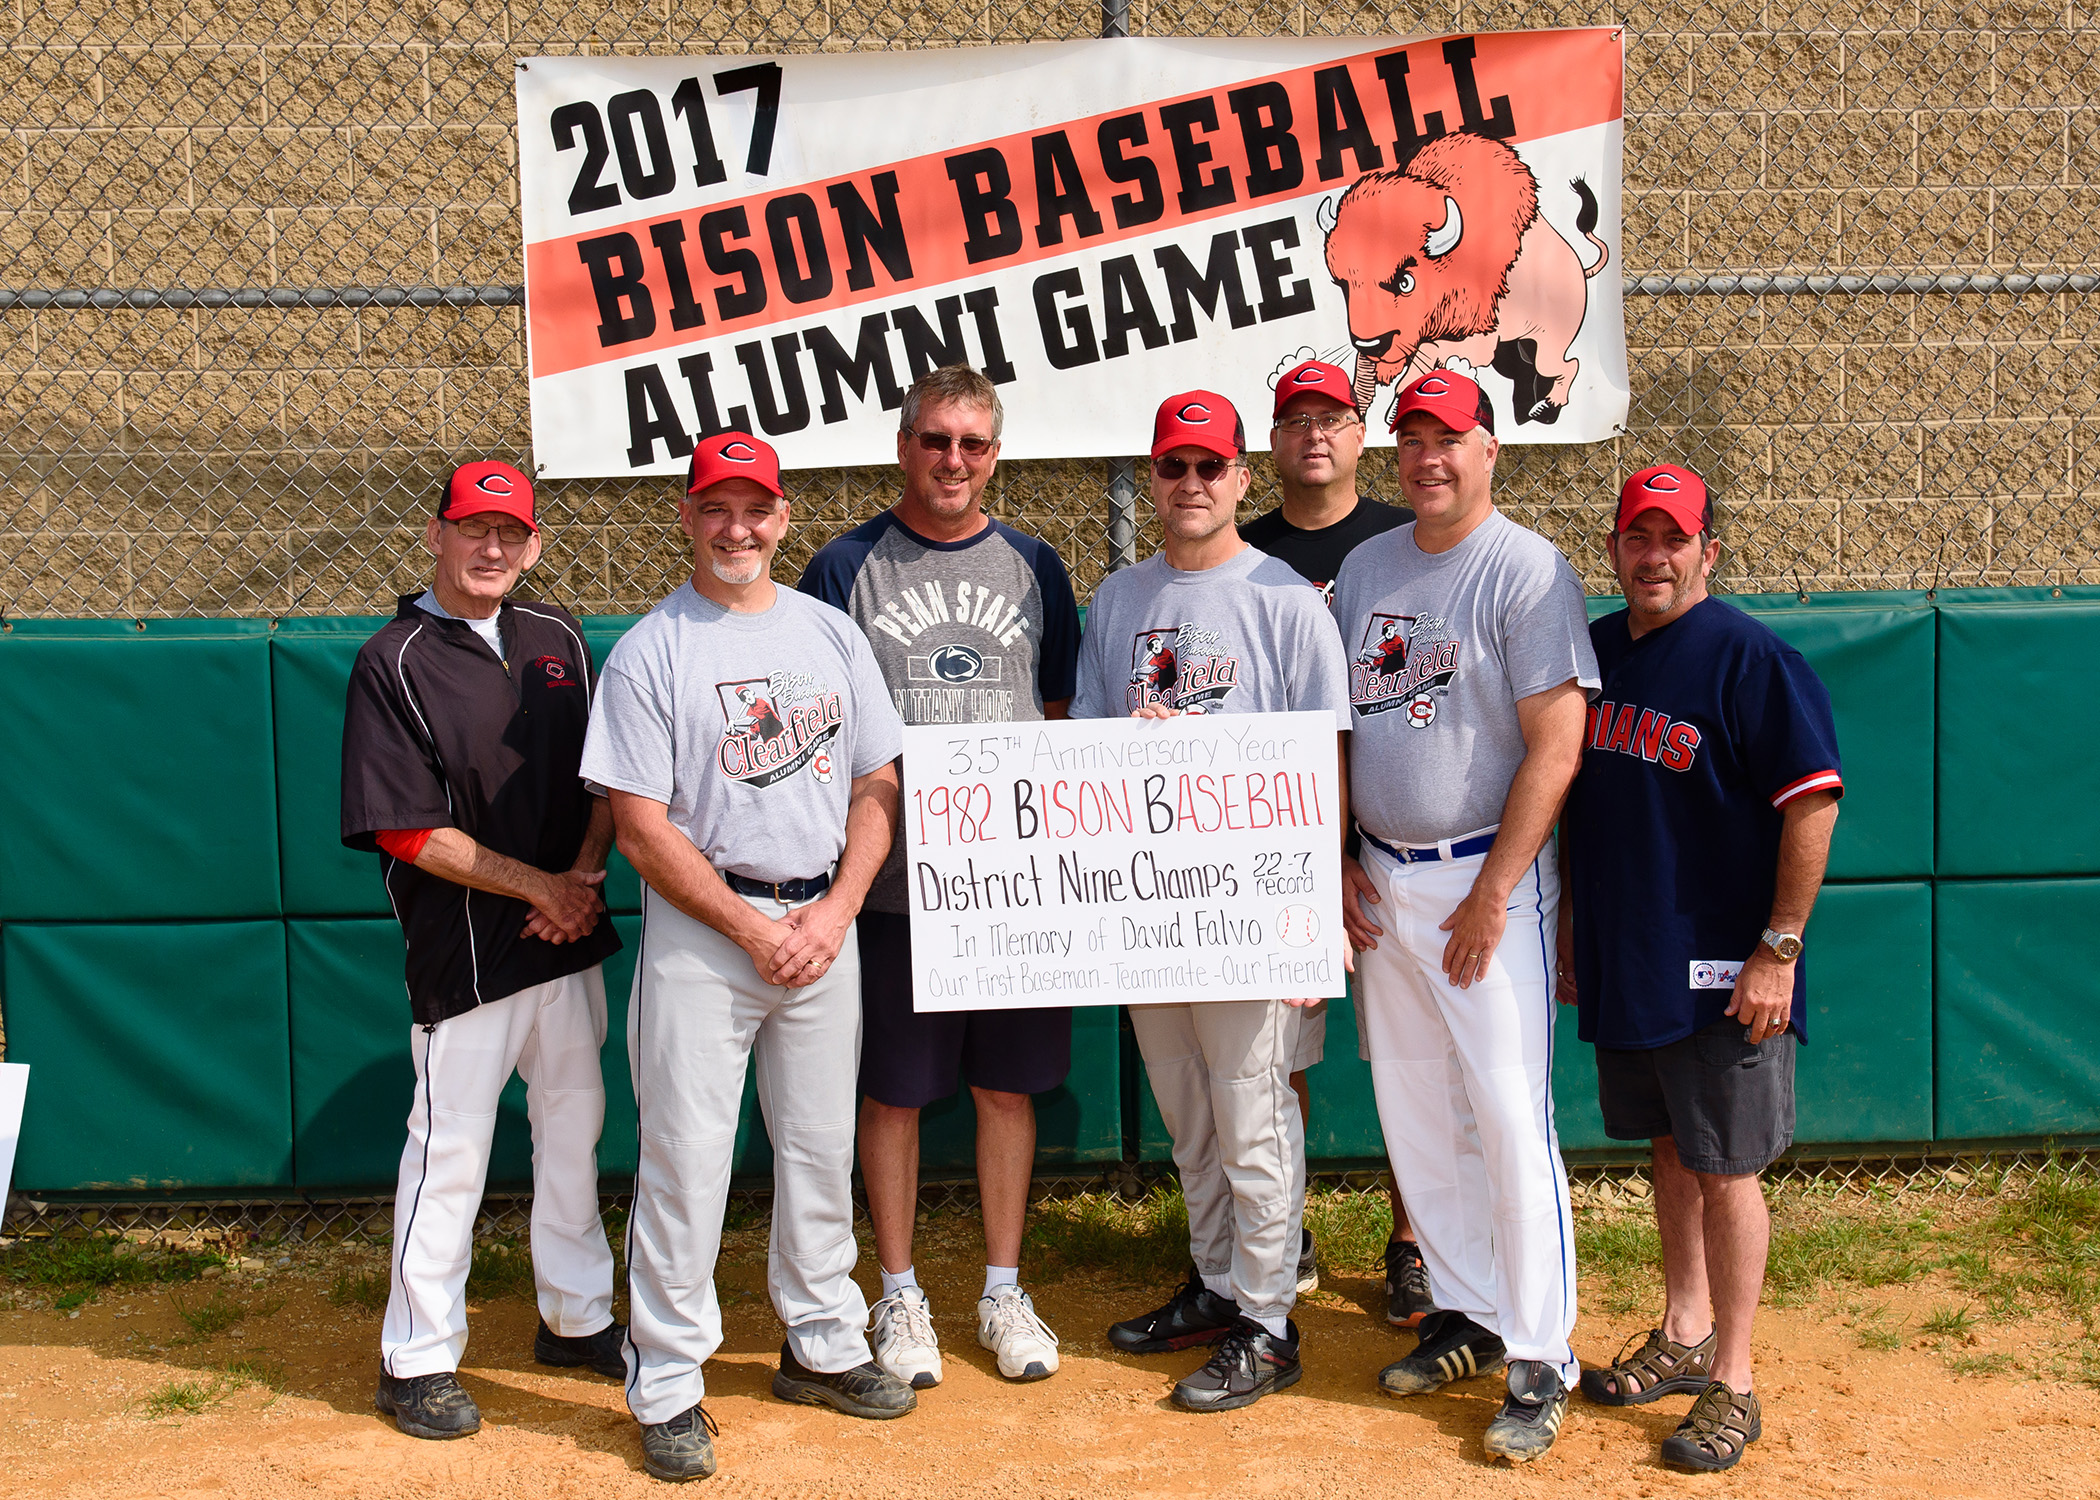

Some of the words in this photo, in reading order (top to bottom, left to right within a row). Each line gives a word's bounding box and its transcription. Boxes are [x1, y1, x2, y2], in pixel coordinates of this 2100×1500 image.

[550, 61, 783, 216] 2017
[577, 170, 914, 348] BISON
[944, 35, 1517, 265] BASEBALL
[625, 287, 1016, 468] ALUMNI
[1032, 217, 1315, 370] GAME
[873, 580, 950, 647] PENN
[956, 581, 1029, 648] STATE
[1174, 621, 1220, 648] Bison
[1409, 611, 1448, 638] Bison
[1180, 641, 1229, 659] Baseball
[767, 669, 815, 698] Bison
[781, 682, 829, 708] Baseball
[970, 688, 1013, 723] LIONS
[1177, 691, 1213, 707] GAME
[1368, 694, 1406, 714] ALUMNI
[1408, 678, 1437, 698] GAME
[717, 691, 844, 778] Clearfield
[769, 753, 807, 783] ALUMNI
[807, 731, 830, 756] GAME
[1029, 730, 1218, 773] Anniversary
[1224, 724, 1297, 762] Year
[913, 782, 997, 846] 1982
[1014, 778, 1133, 839] BISON
[916, 854, 1042, 912] District
[1058, 850, 1127, 904] Nine
[1131, 850, 1239, 901] Champs
[1256, 869, 1314, 896] record
[950, 924, 977, 958] In
[988, 922, 1072, 958] Memory
[1088, 916, 1108, 951] of
[1122, 911, 1185, 950] David
[1195, 909, 1262, 946] Falvo
[929, 968, 969, 997] Our
[975, 965, 1015, 996] First
[1267, 948, 1333, 985] Friend
